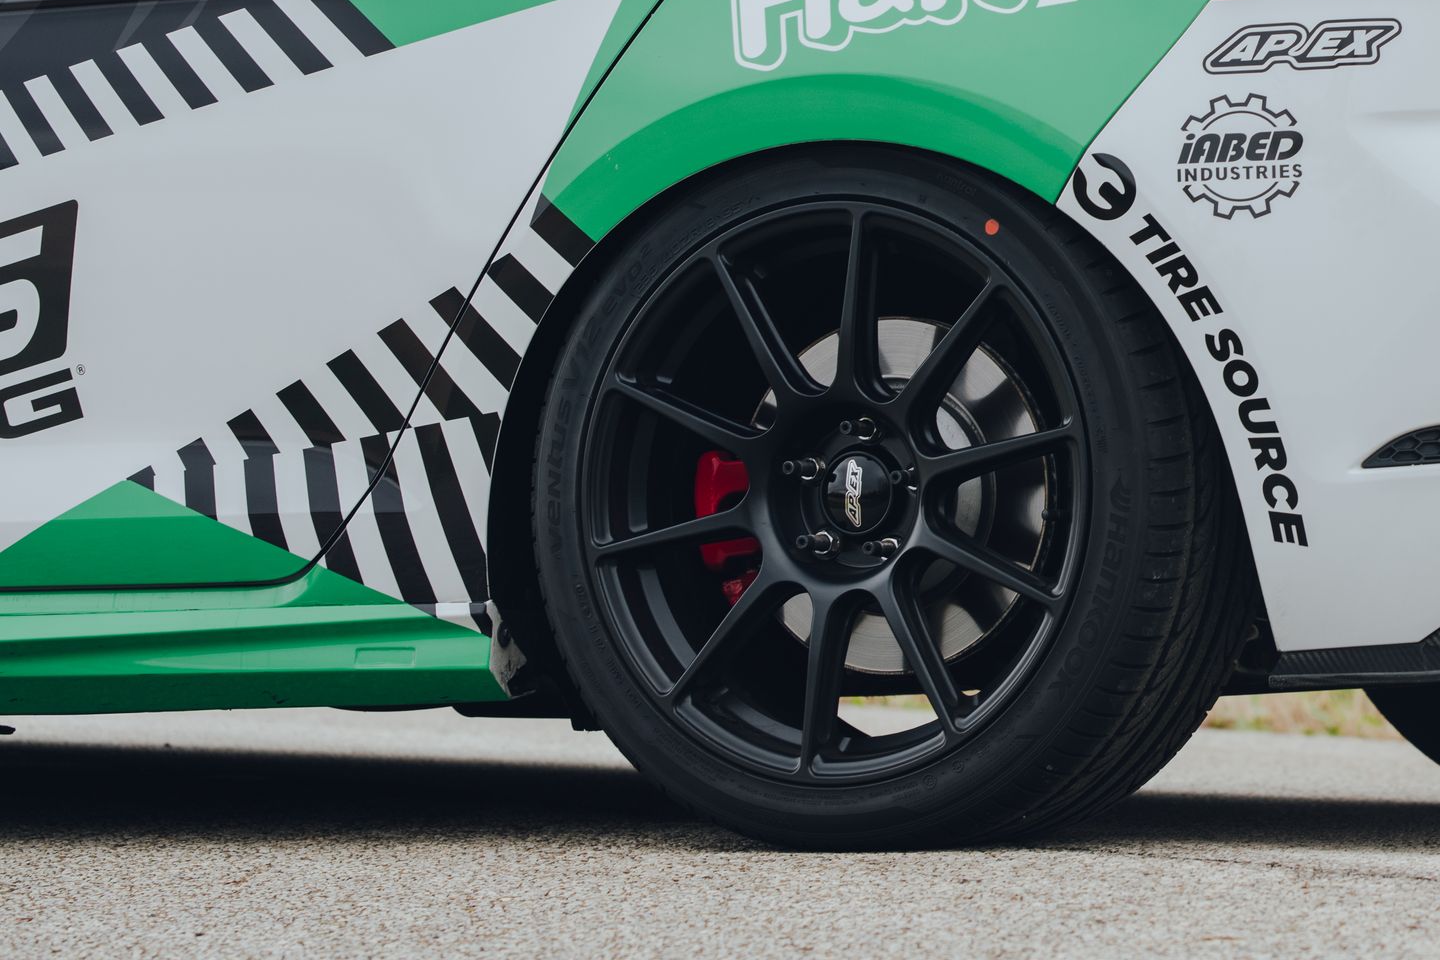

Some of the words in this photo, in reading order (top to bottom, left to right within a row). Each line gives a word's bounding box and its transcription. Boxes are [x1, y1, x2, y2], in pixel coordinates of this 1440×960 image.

[1210, 23, 1395, 68] APEX
[1177, 164, 1303, 182] INDUSTRIES
[1129, 213, 1224, 322] TIRE
[1205, 329, 1309, 547] SOURCE
